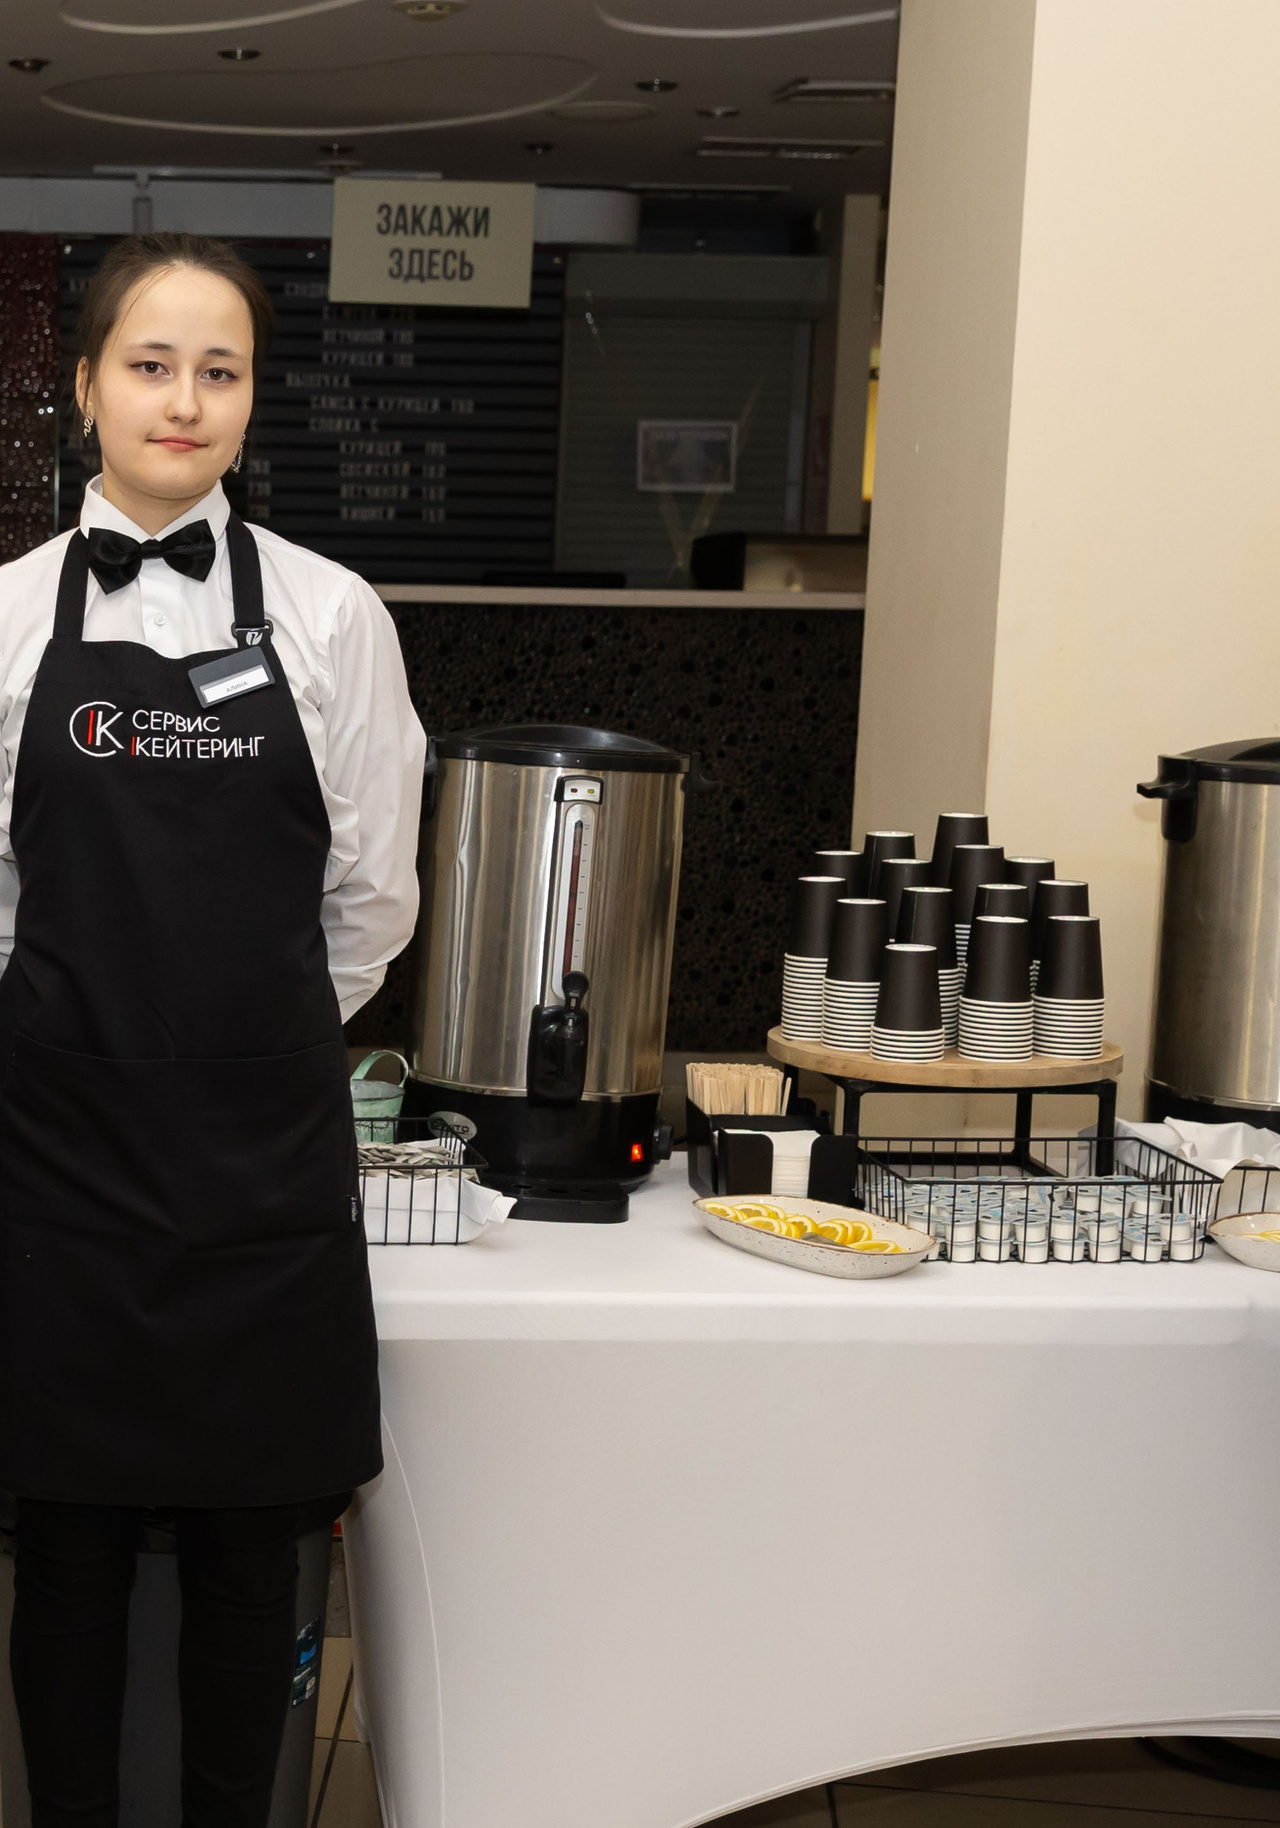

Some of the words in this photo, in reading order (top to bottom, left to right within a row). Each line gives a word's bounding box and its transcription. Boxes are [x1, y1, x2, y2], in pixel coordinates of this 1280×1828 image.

[376, 204, 490, 238] ЗАКАЖИ
[389, 248, 474, 283] ЗДЕСЬ
[311, 396, 354, 411] САМСА
[226, 681, 248, 693] АЛИНА
[132, 709, 220, 732] СЕРВИС
[134, 735, 265, 758] КЕЙТЕРИНГ
